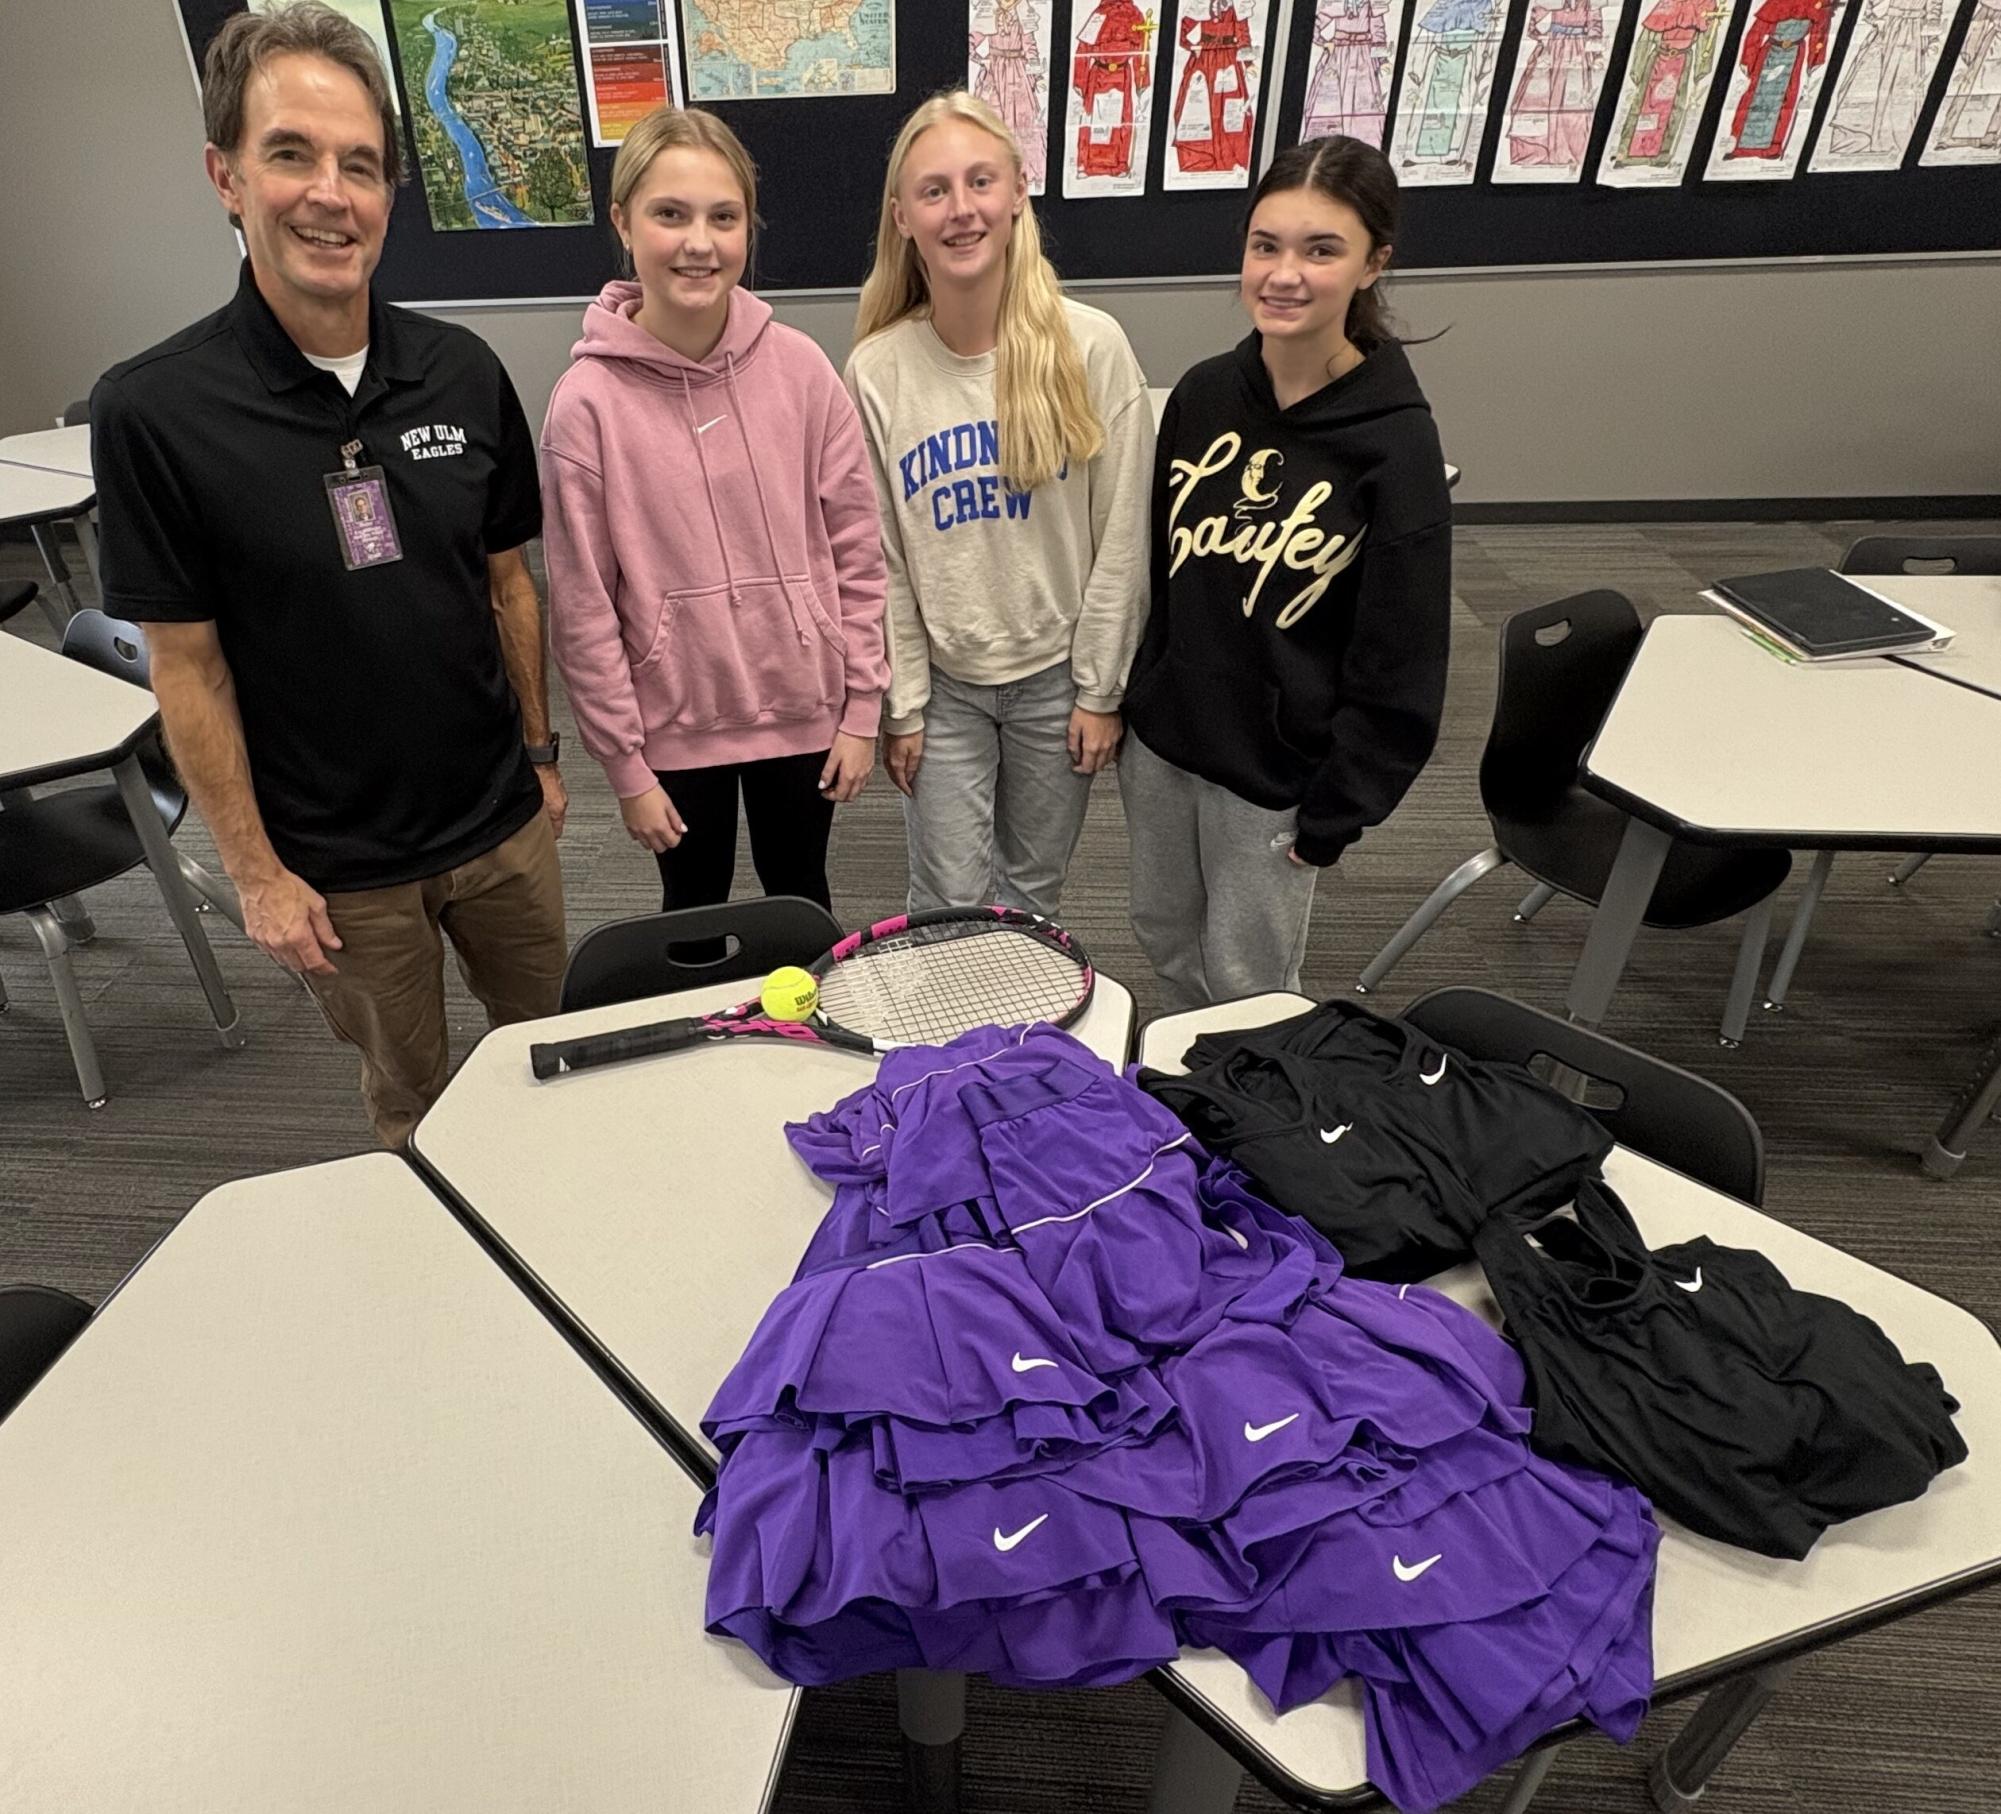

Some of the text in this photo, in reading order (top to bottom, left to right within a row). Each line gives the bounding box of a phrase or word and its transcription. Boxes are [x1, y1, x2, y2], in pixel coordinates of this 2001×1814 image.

[400, 424, 468, 452] NEW ULM
[411, 443, 463, 460] EAGLES
[899, 420, 1068, 503] KINDN
[932, 476, 1032, 531] CREW
